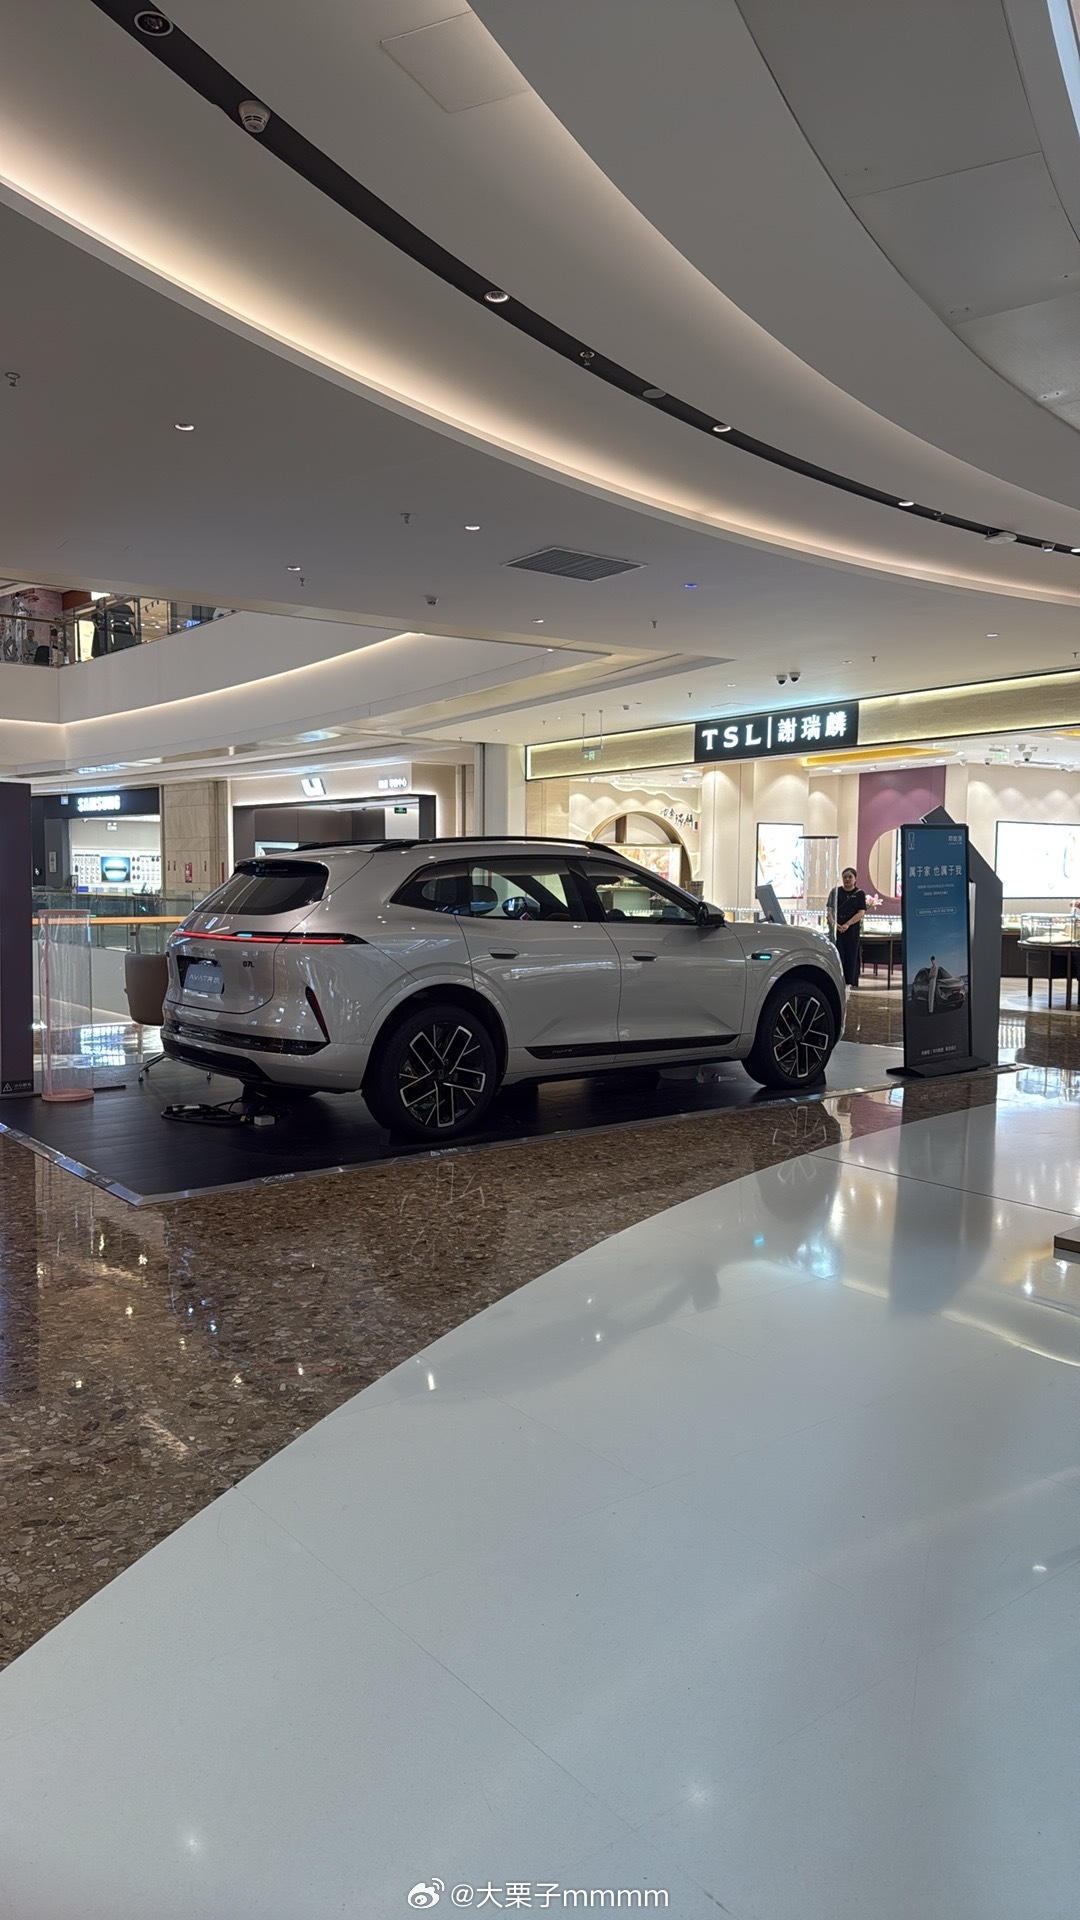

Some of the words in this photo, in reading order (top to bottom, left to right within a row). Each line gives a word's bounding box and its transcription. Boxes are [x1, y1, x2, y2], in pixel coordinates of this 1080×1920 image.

[702, 724, 762, 750] TSL
[777, 711, 848, 743] 謝瑞麟
